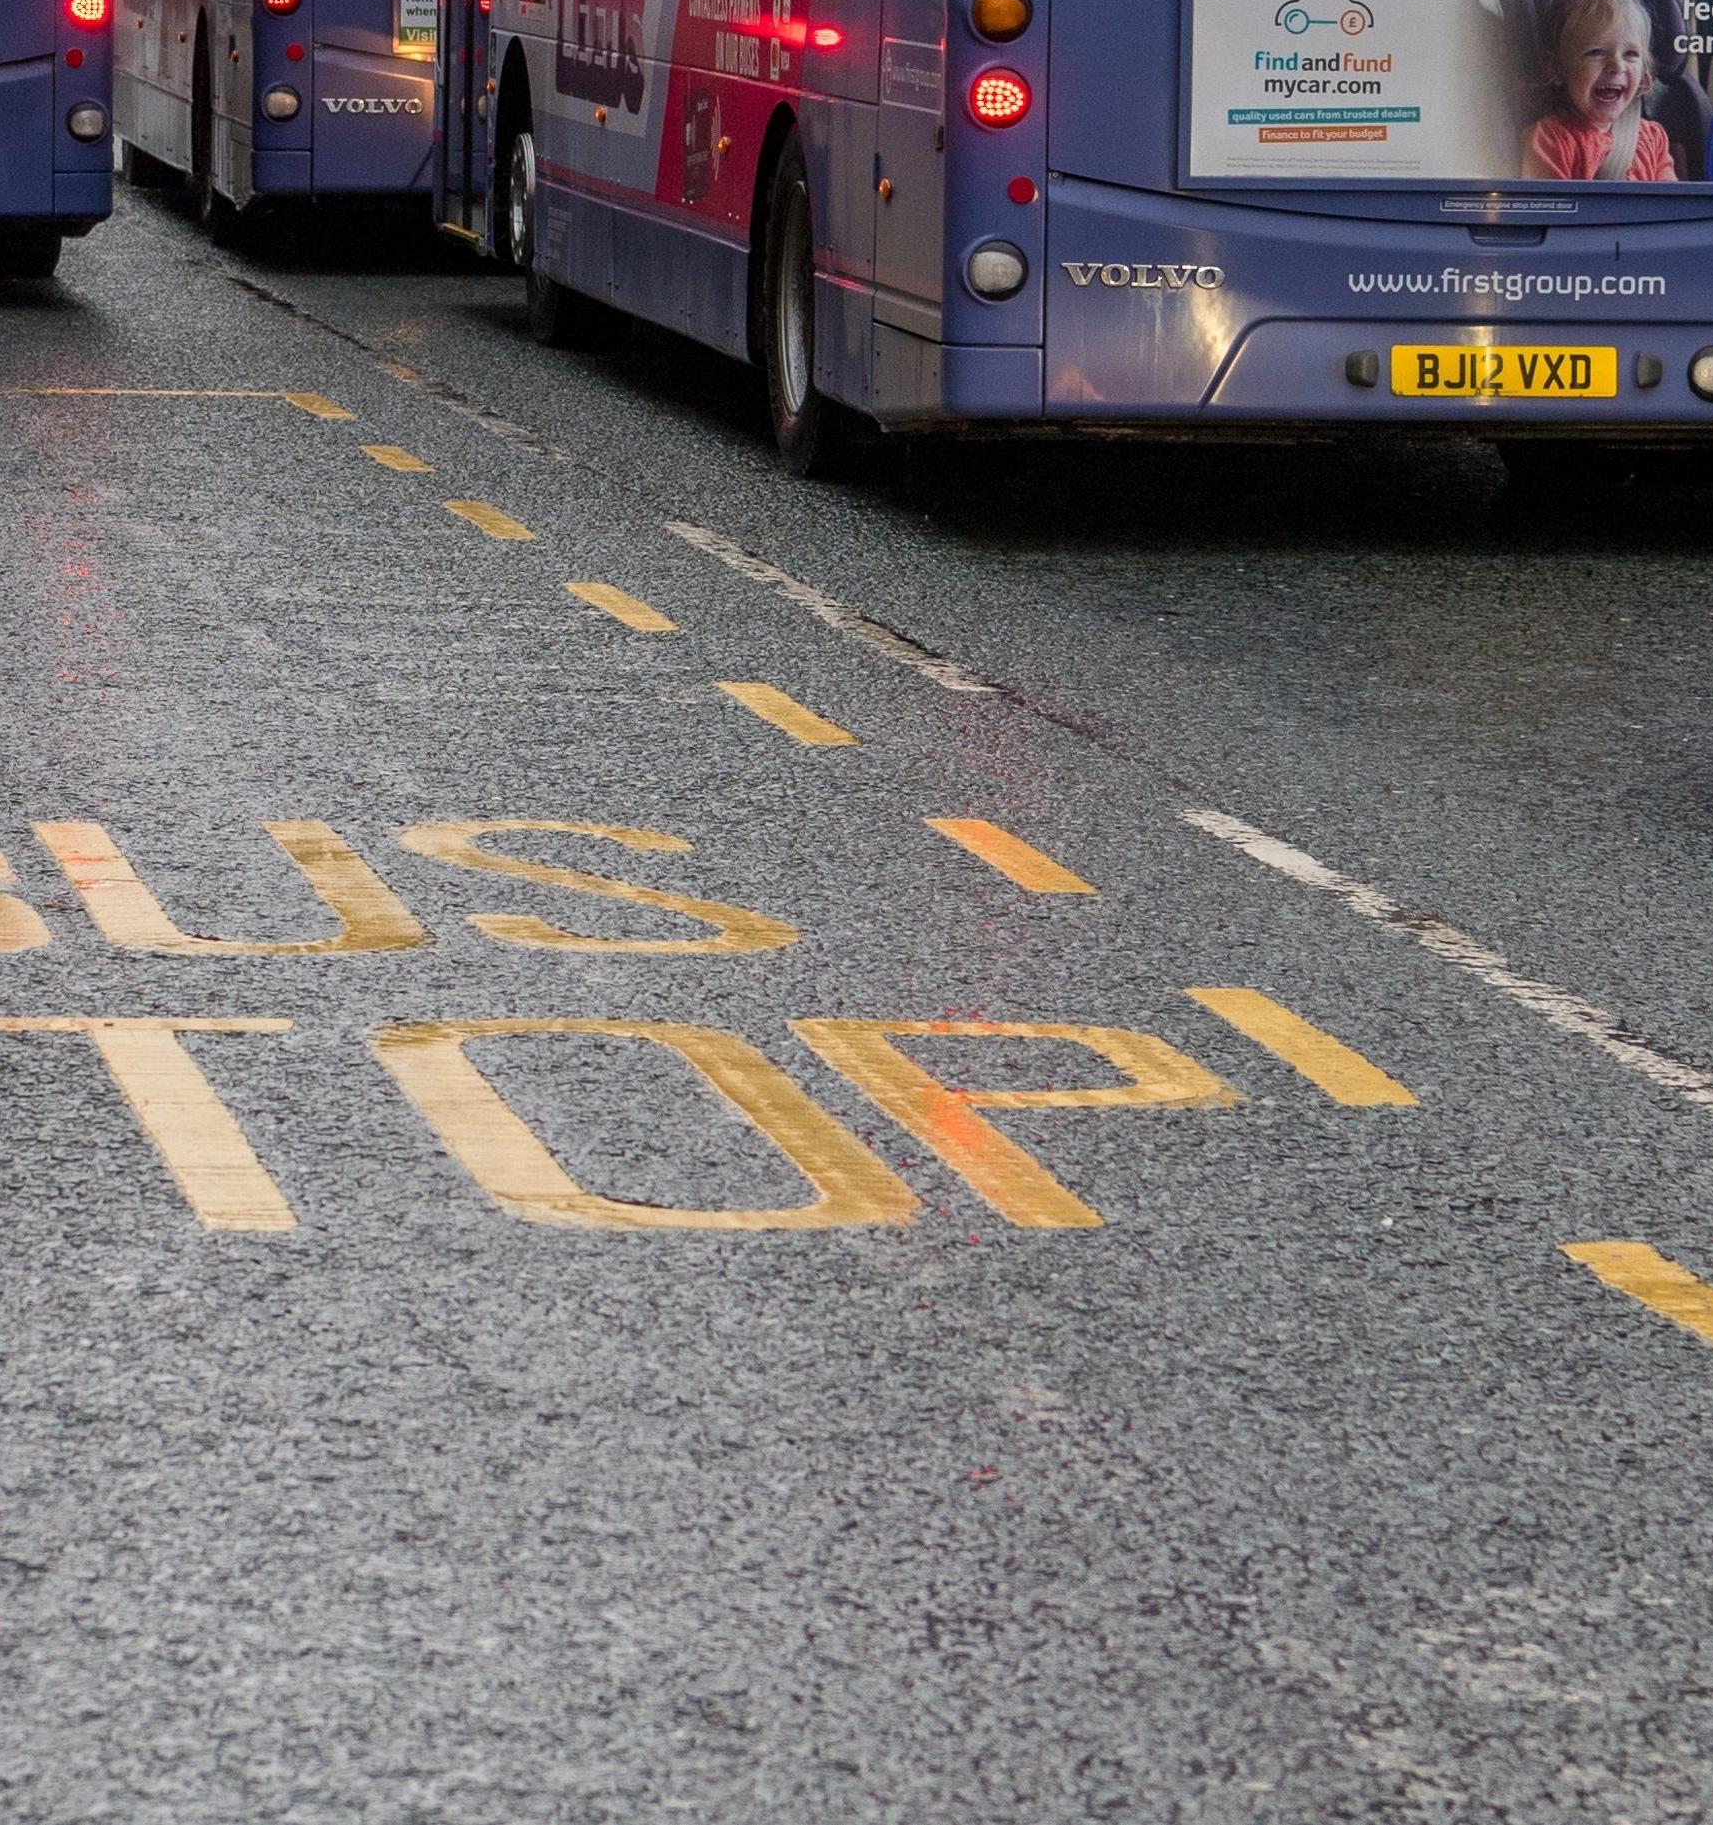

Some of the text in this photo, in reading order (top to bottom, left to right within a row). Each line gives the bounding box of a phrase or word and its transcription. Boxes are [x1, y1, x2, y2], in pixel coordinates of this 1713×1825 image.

[406, 6, 437, 17] when
[715, 30, 760, 78] ON OUR BUSES
[1264, 78, 1382, 98] mycar.com
[322, 96, 424, 116] VOLVO
[1232, 108, 1417, 123] quality used cars from trusted dealers
[1300, 128, 1383, 141] to fit your budget
[1445, 199, 1555, 211] Emergency stop behind
[1061, 262, 1226, 291] VOLVO
[1347, 268, 1666, 302] www.firstgroup.com
[1416, 352, 1593, 392] BJ12 VXD
